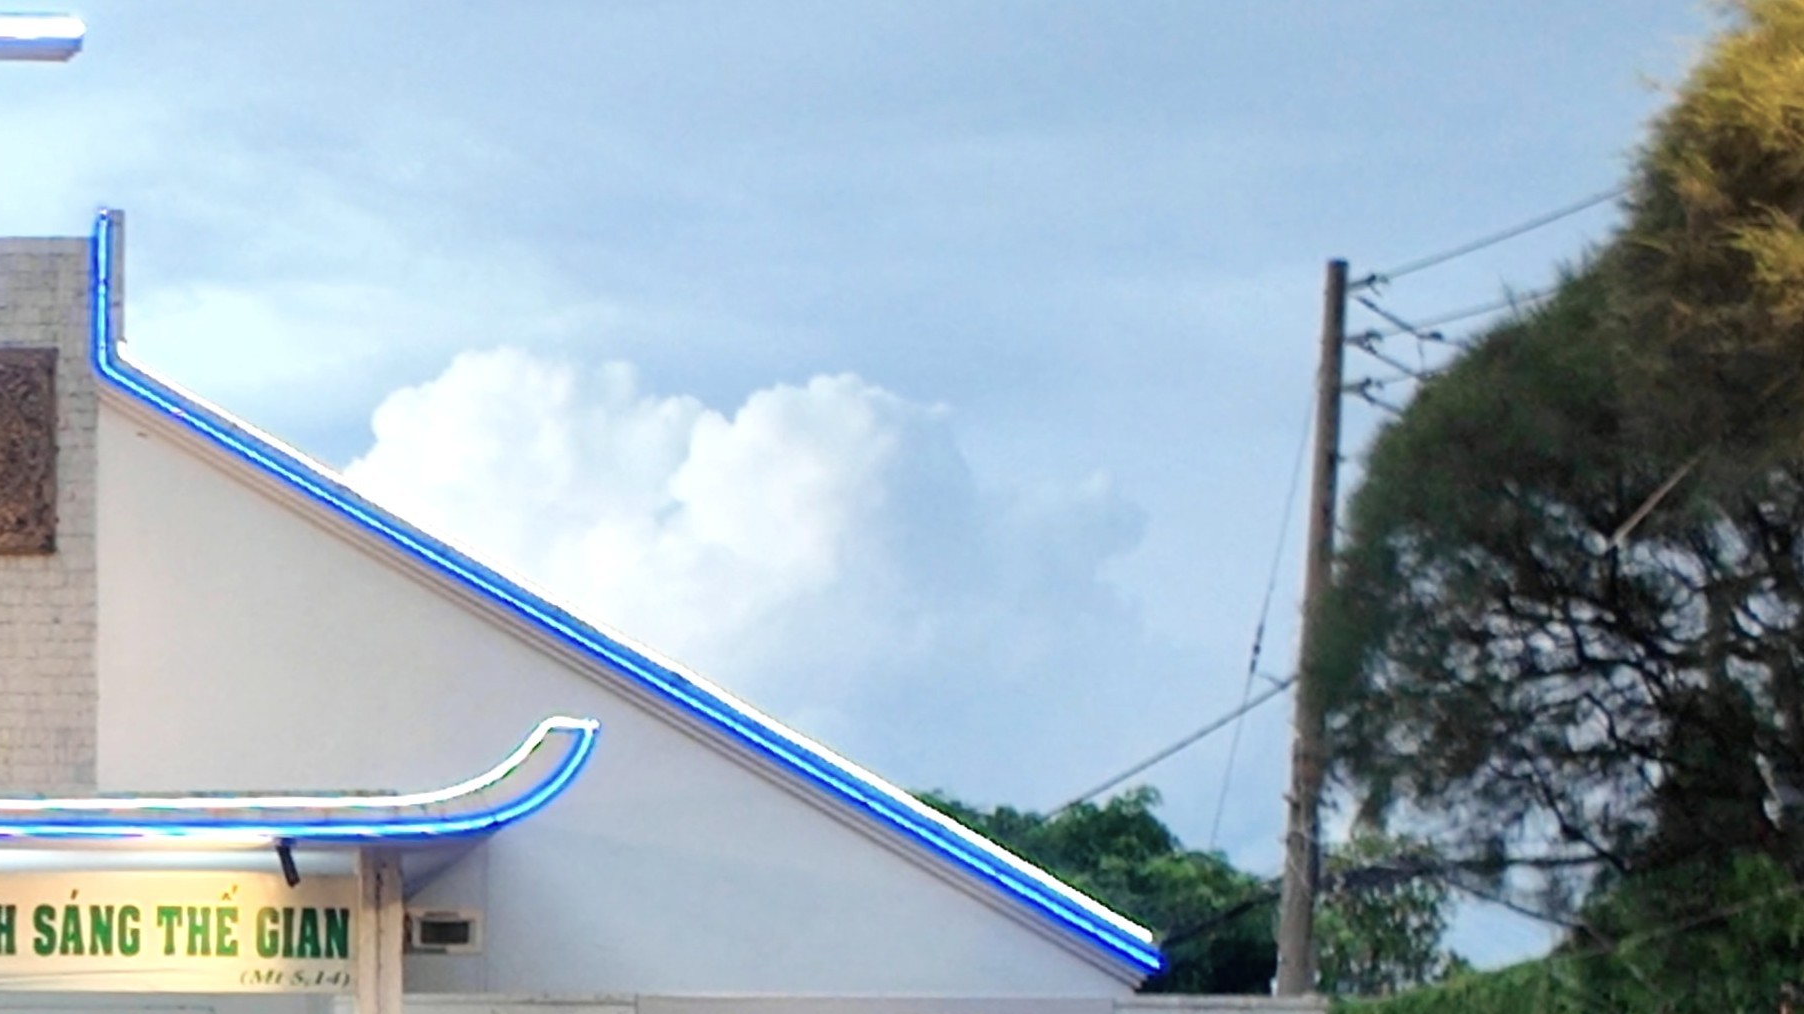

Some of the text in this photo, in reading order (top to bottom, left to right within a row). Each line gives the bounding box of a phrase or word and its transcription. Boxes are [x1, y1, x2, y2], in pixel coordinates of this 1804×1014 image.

[32, 888, 141, 957] SÁNG
[156, 885, 240, 957] THẾ
[255, 906, 351, 960] GIAN
